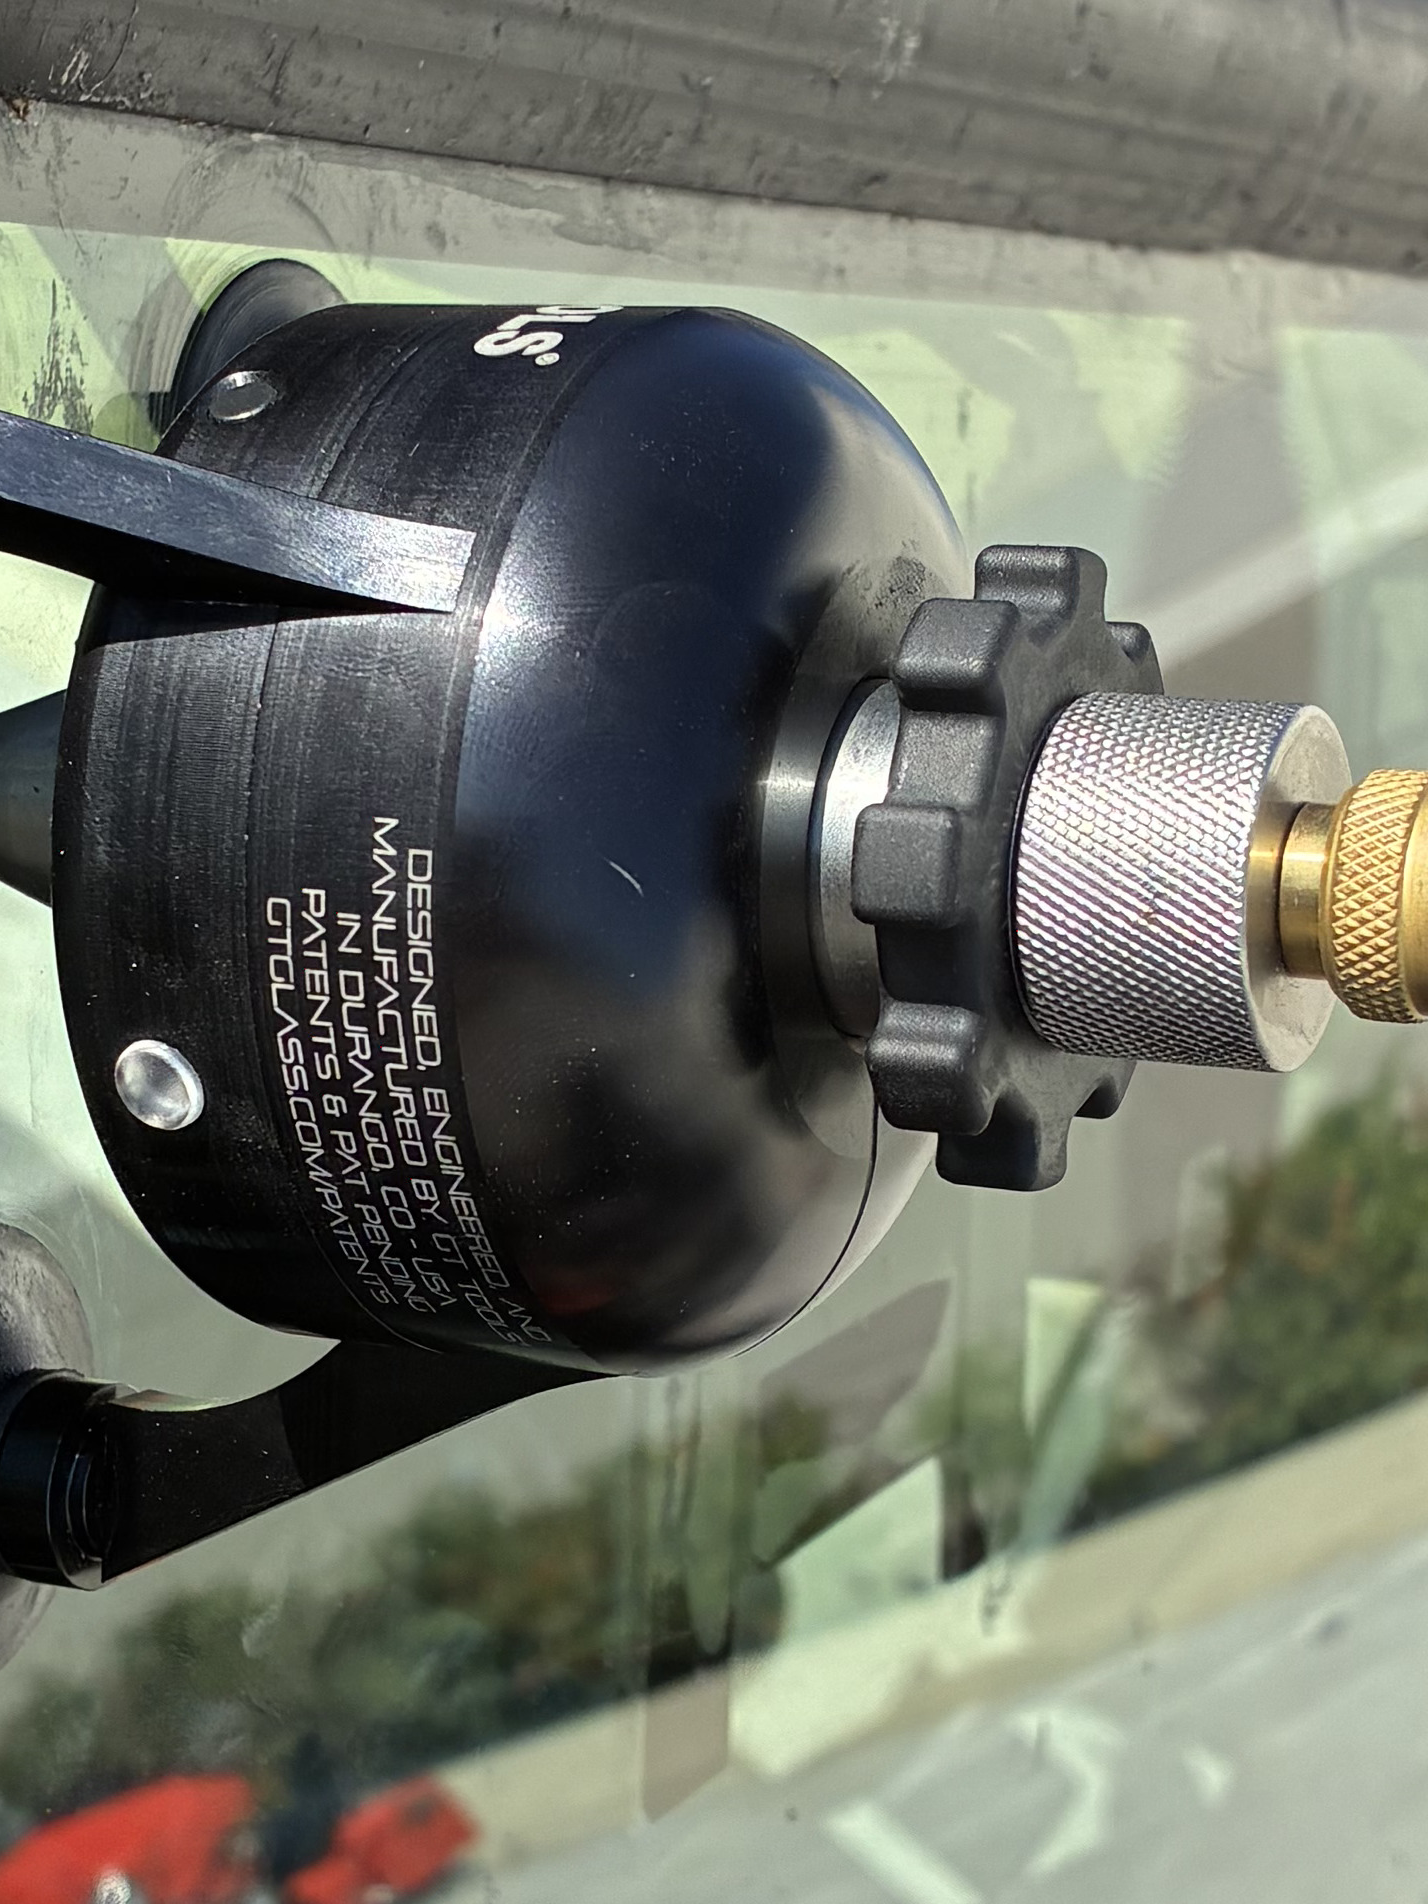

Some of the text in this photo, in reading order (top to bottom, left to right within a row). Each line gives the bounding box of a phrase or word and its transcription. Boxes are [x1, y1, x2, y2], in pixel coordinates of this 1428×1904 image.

[337, 912, 362, 953] IN
[338, 970, 394, 1171] DURANGO,
[372, 817, 427, 1166] MANUFACTURED
[432, 1233, 468, 1270] GT
[458, 1278, 530, 1346] TOOLS
[267, 897, 398, 1304] GTGLASS.COM/PATENTS
[301, 888, 436, 1313] PATENTS & PAT PENDING
[380, 1186, 416, 1229] CO
[407, 848, 552, 1342] DESIGNED, ENGINEERED, AND
[412, 1257, 457, 1306] USA
